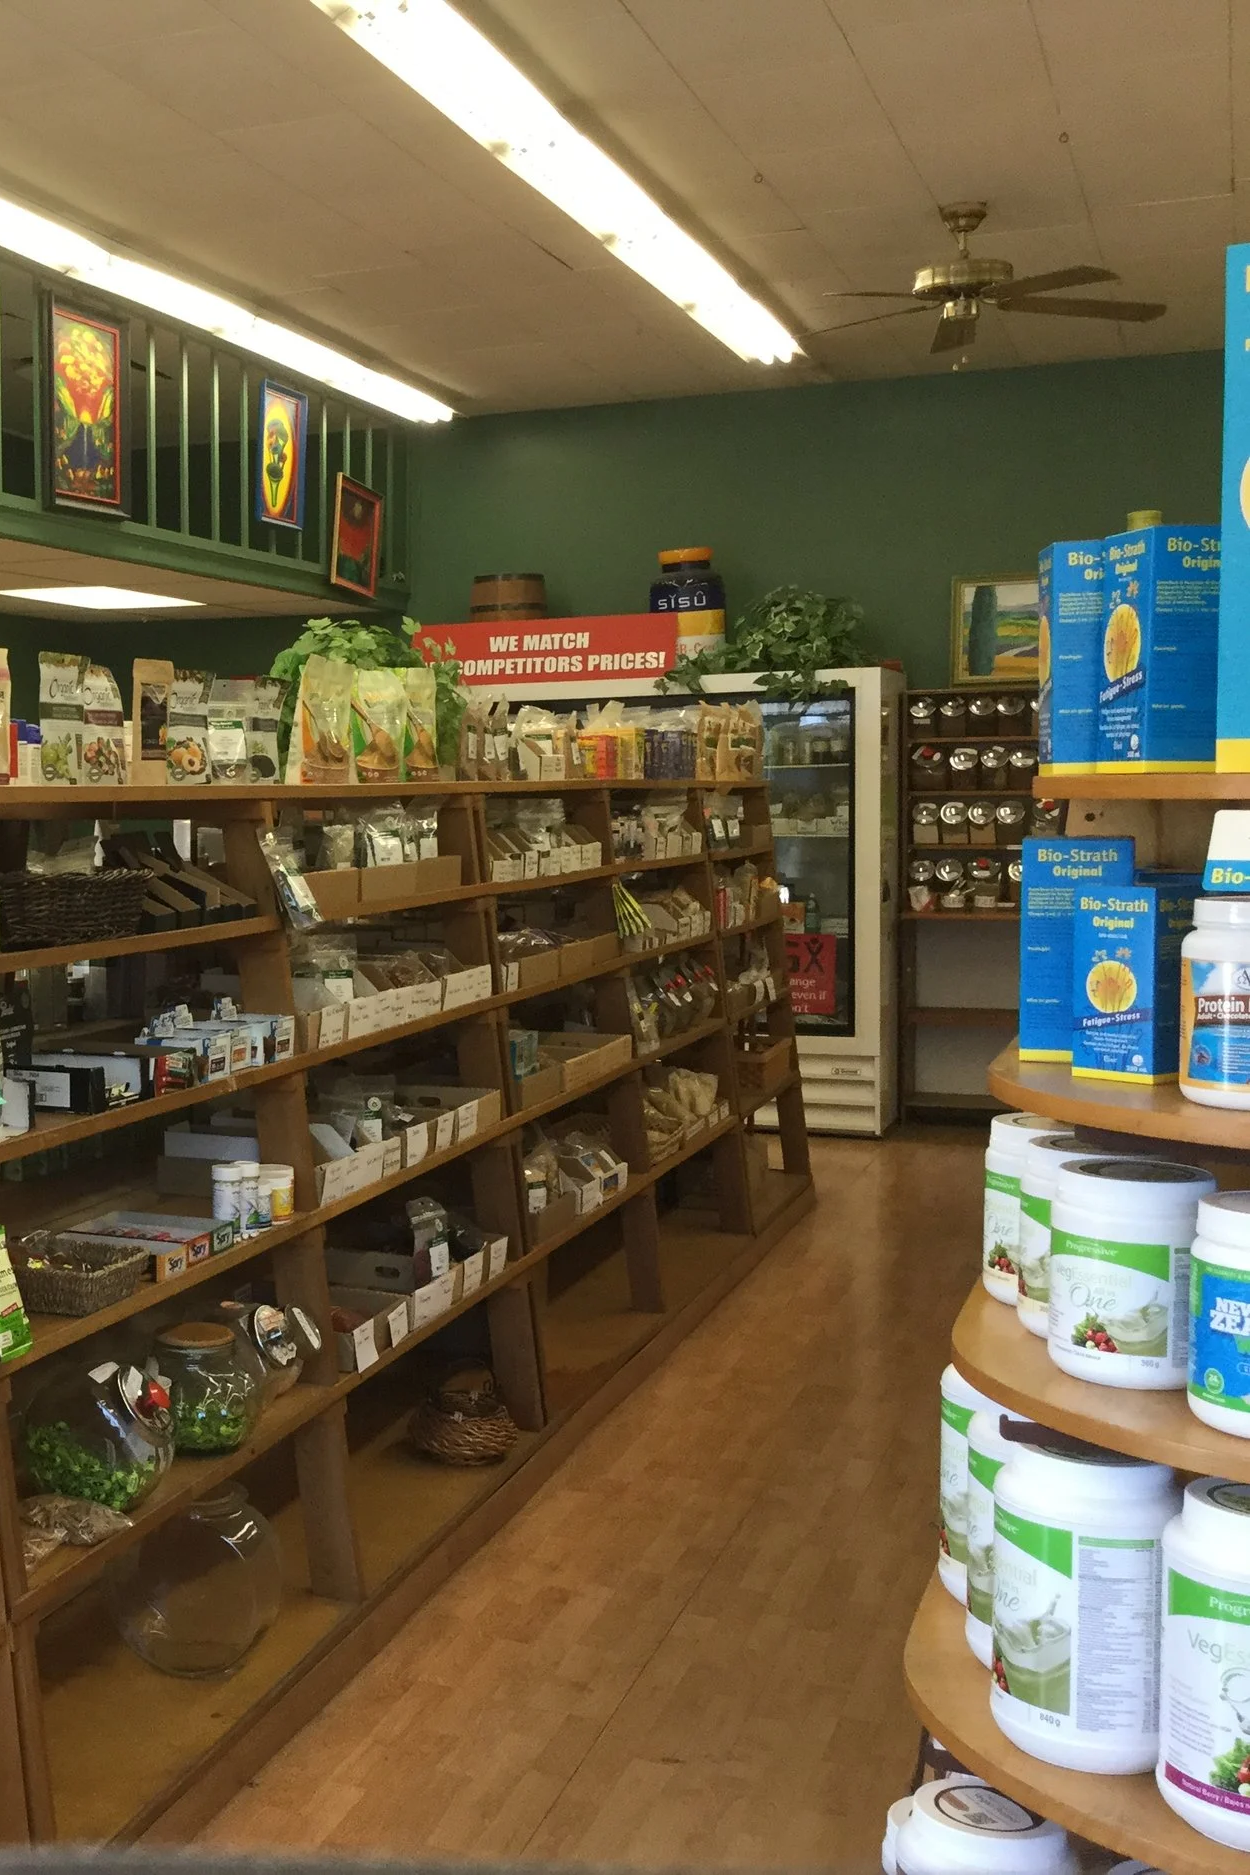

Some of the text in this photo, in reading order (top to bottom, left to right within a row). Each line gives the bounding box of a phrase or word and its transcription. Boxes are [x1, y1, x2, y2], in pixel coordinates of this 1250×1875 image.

[1109, 539, 1145, 562] Bio-Strath
[489, 632, 590, 653] WE MATCH
[456, 651, 666, 677] COMPETITORS PRICES!
[1037, 847, 1118, 864] Bio-Strath
[1052, 864, 1103, 879] Original
[1080, 895, 1148, 914] Bio-Strath
[1092, 915, 1135, 930] Original
[1198, 998, 1244, 1013] Protein
